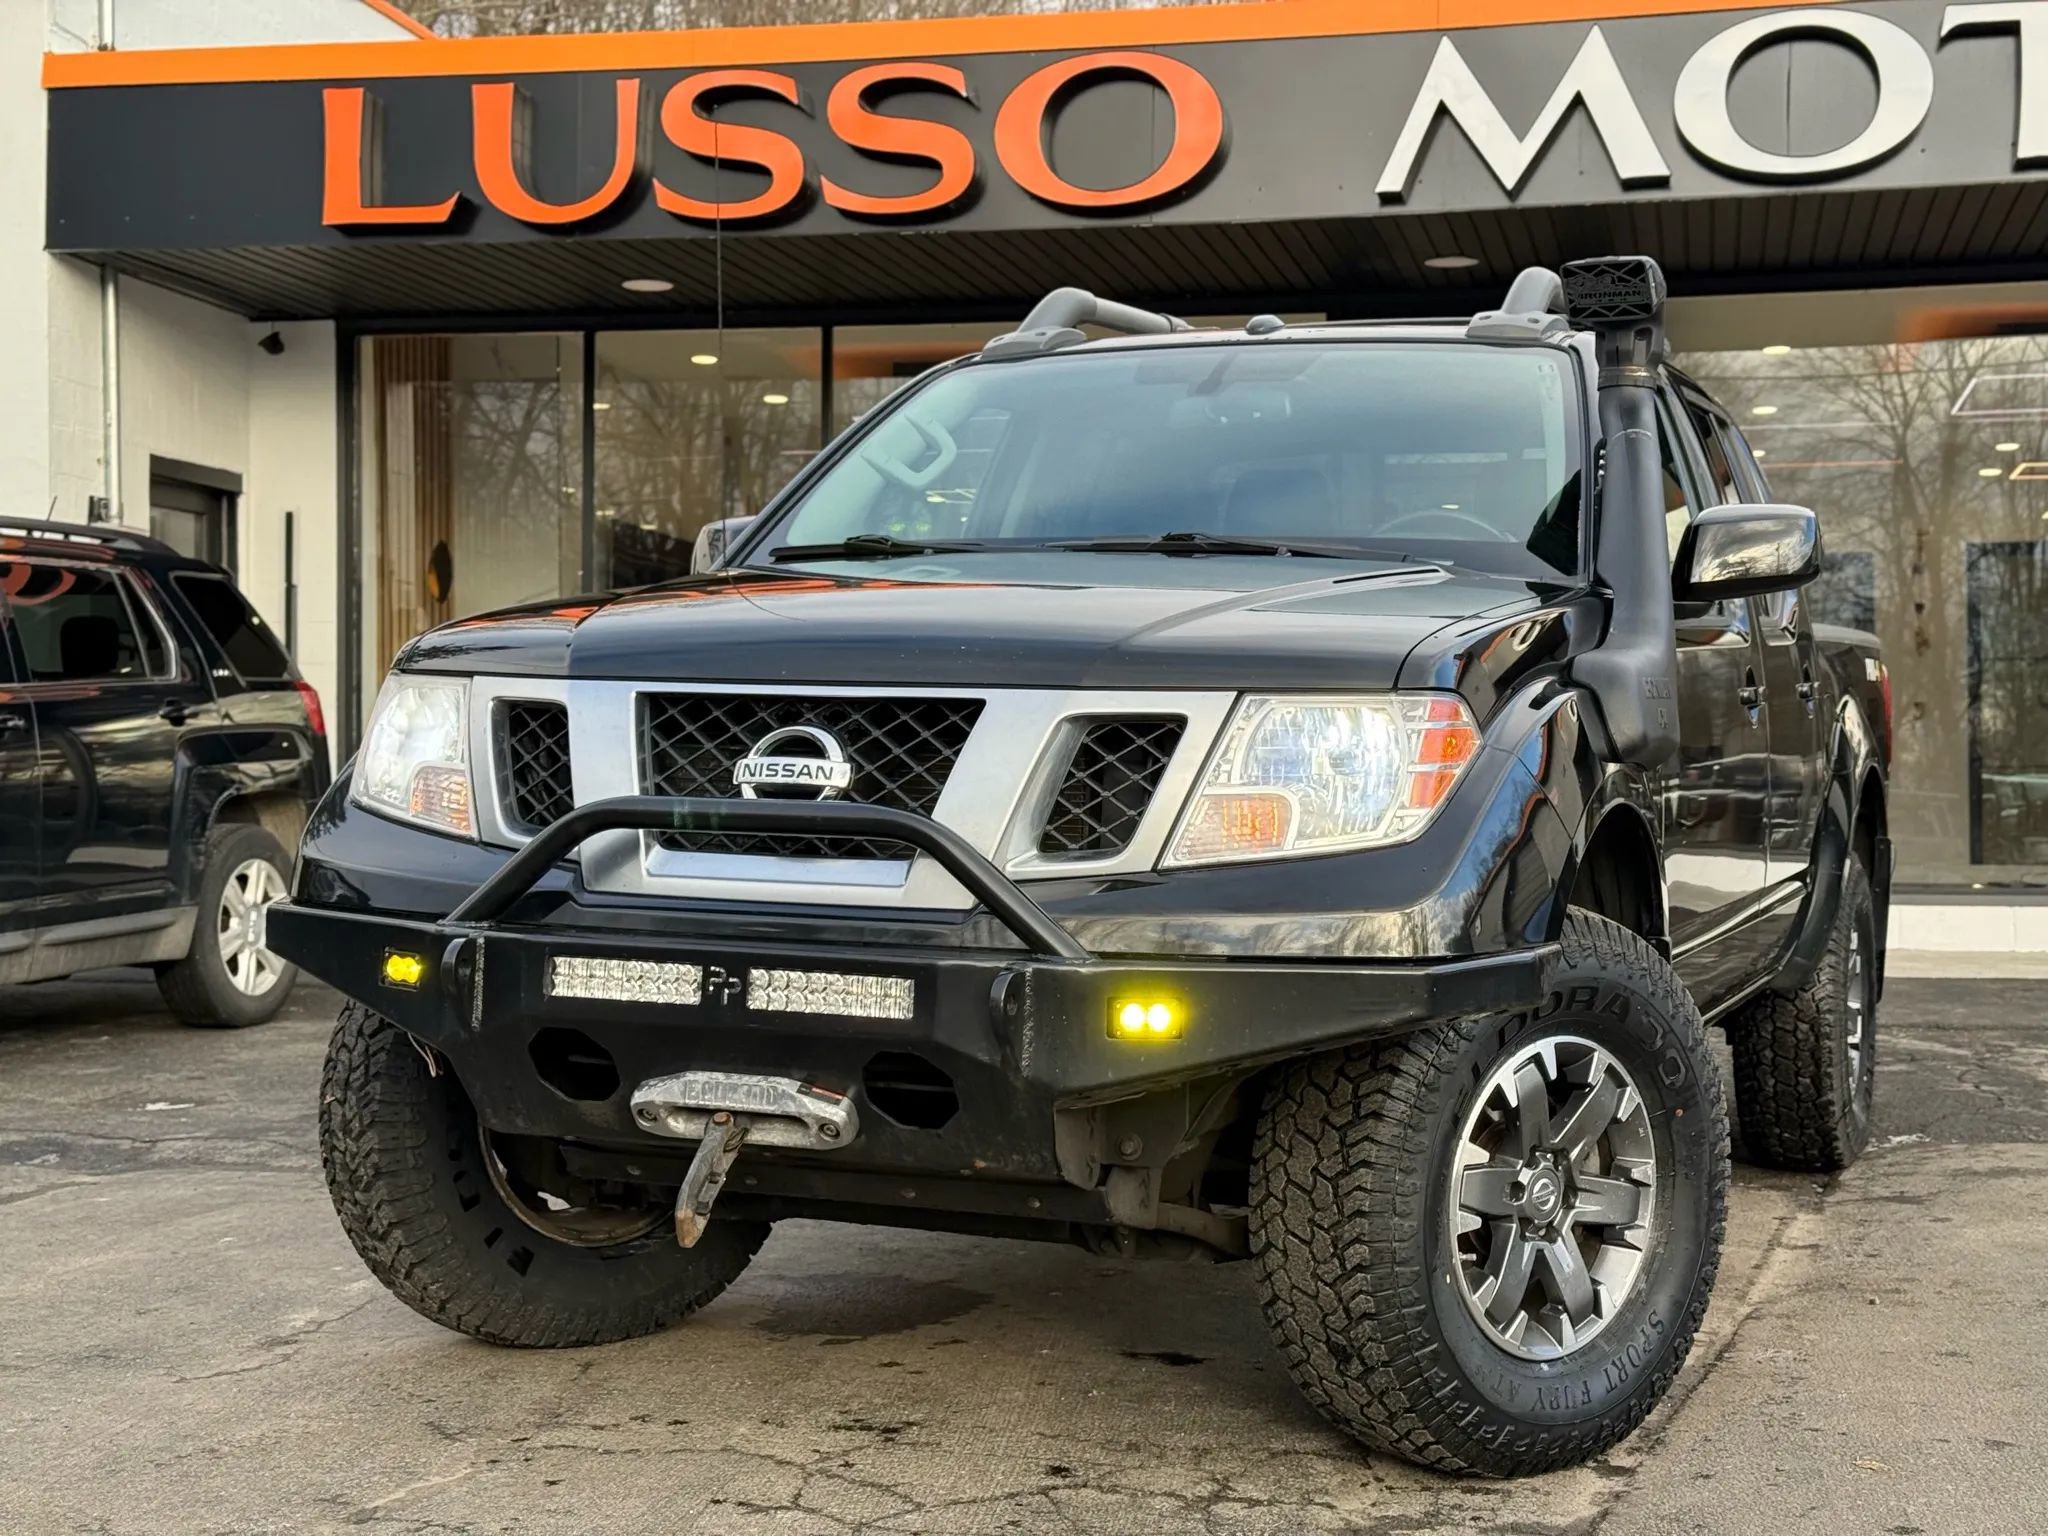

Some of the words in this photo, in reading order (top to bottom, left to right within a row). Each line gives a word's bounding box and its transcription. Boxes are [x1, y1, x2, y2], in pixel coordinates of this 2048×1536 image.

[322, 51, 1223, 226] LUSSO
[1579, 289, 1641, 300] IRONMAN
[742, 763, 834, 780] NISSAN
[1603, 1309, 1666, 1396] SPORT
[1530, 1379, 1592, 1412] FURY
